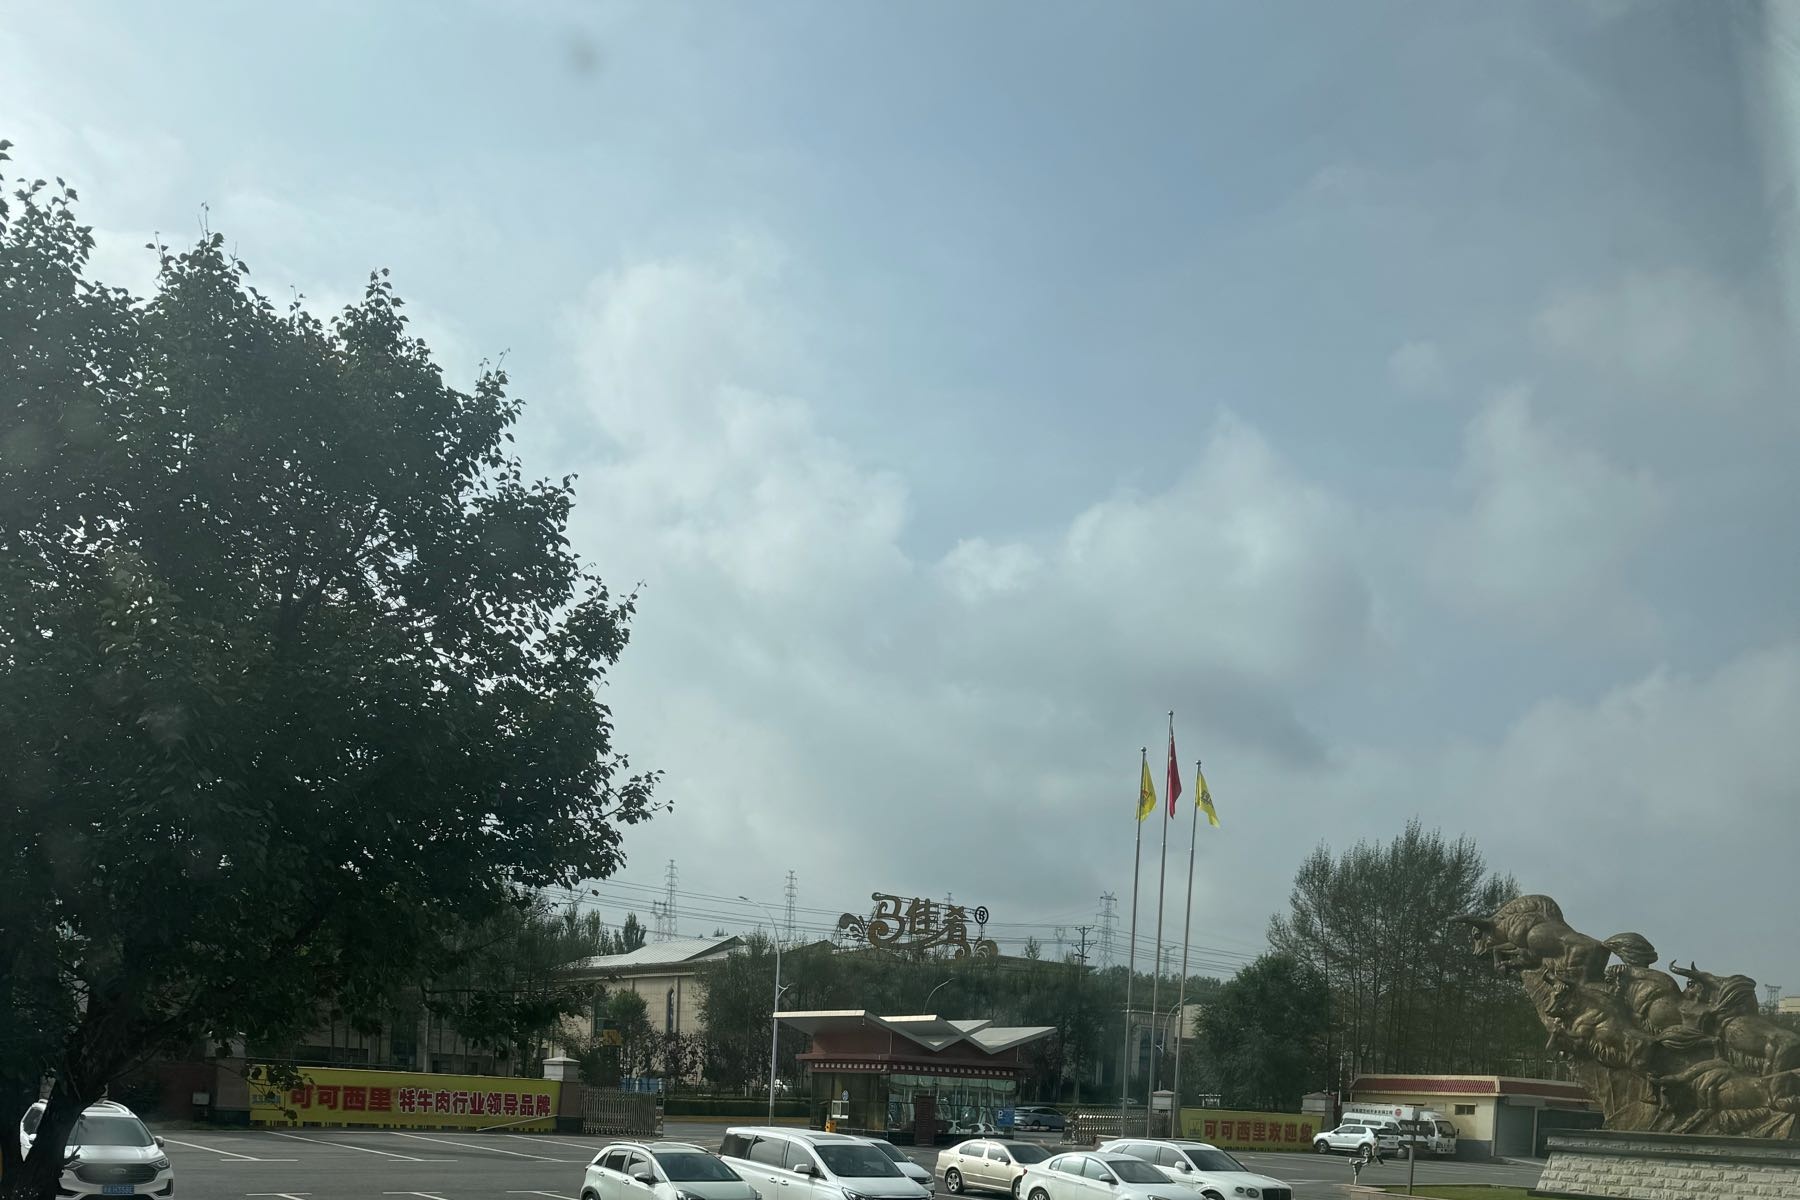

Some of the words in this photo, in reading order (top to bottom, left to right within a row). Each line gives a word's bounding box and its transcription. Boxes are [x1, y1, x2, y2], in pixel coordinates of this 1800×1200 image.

[1204, 1118, 1313, 1143] 可可西里欢迎您
